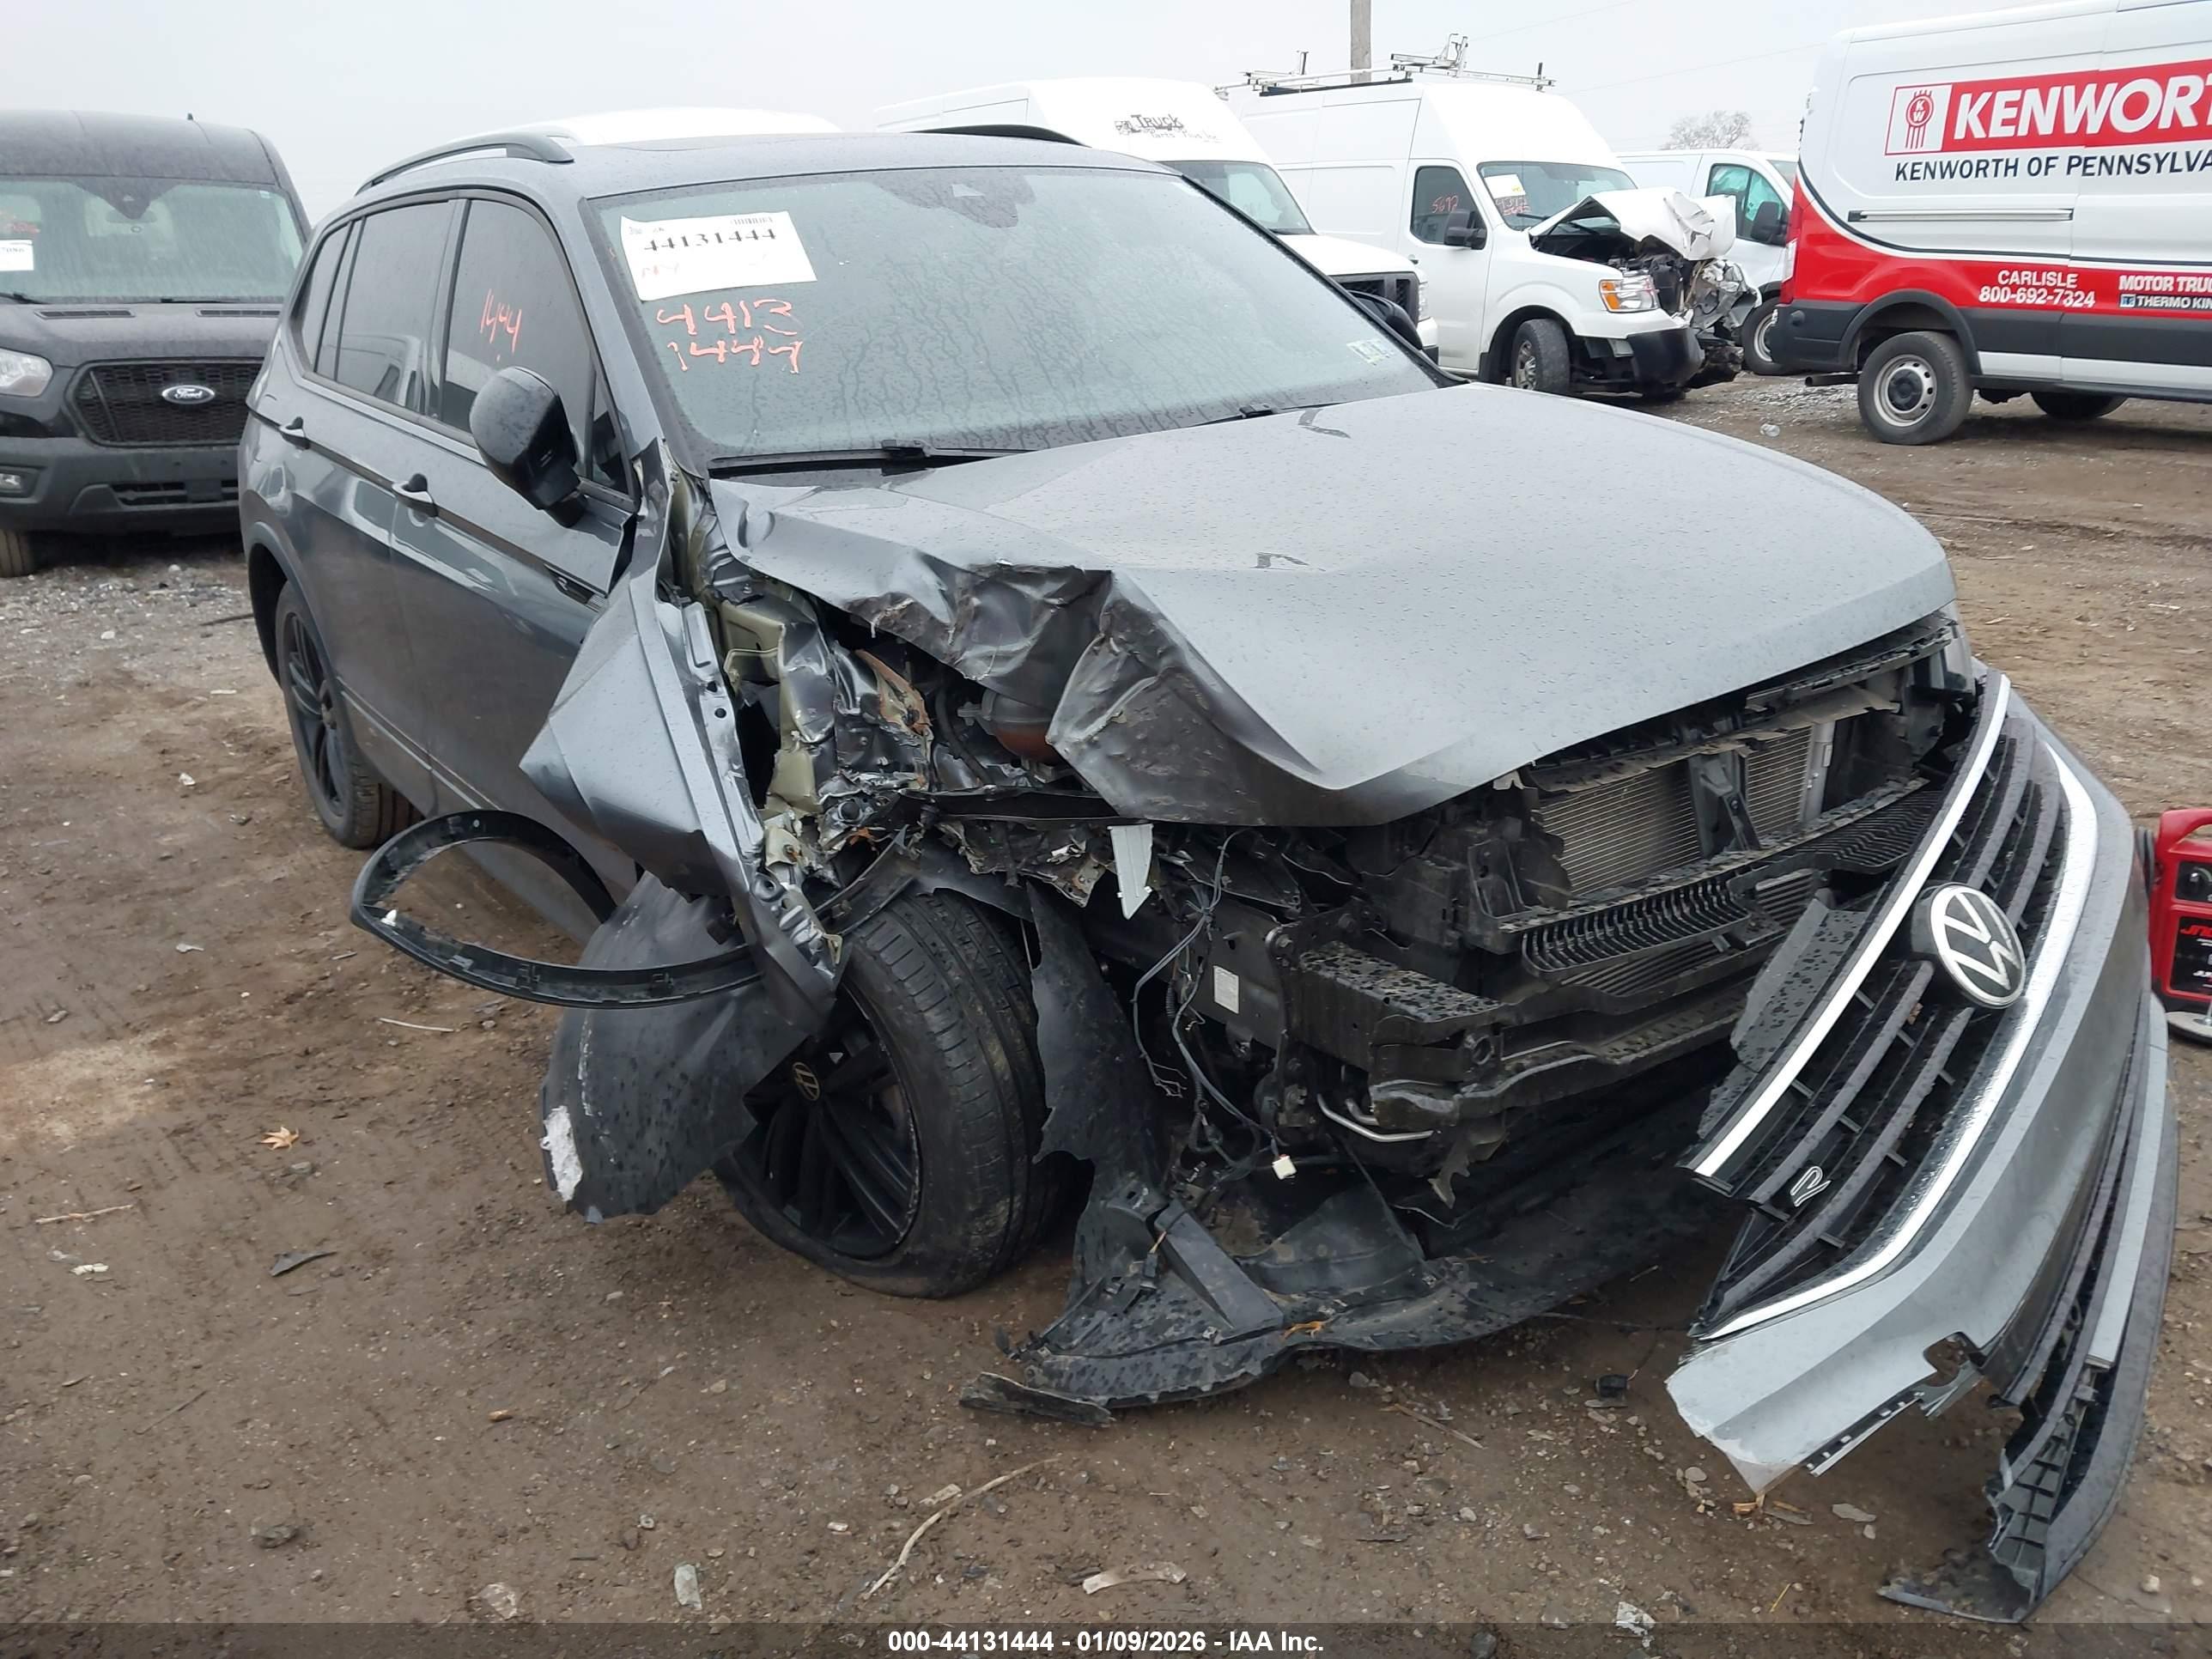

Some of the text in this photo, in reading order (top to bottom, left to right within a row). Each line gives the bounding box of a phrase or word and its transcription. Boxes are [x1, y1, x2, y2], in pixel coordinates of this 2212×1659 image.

[1895, 157, 2019, 181] KENWORTH
[2027, 155, 2059, 177] OF
[644, 228, 776, 252] 44131444
[1997, 270, 2078, 289] CARLISLE
[2118, 275, 2174, 291] MOTOR
[1978, 286, 2095, 308] 800-692-7324
[2136, 295, 2191, 308] THERMO
[657, 299, 802, 336] 4413
